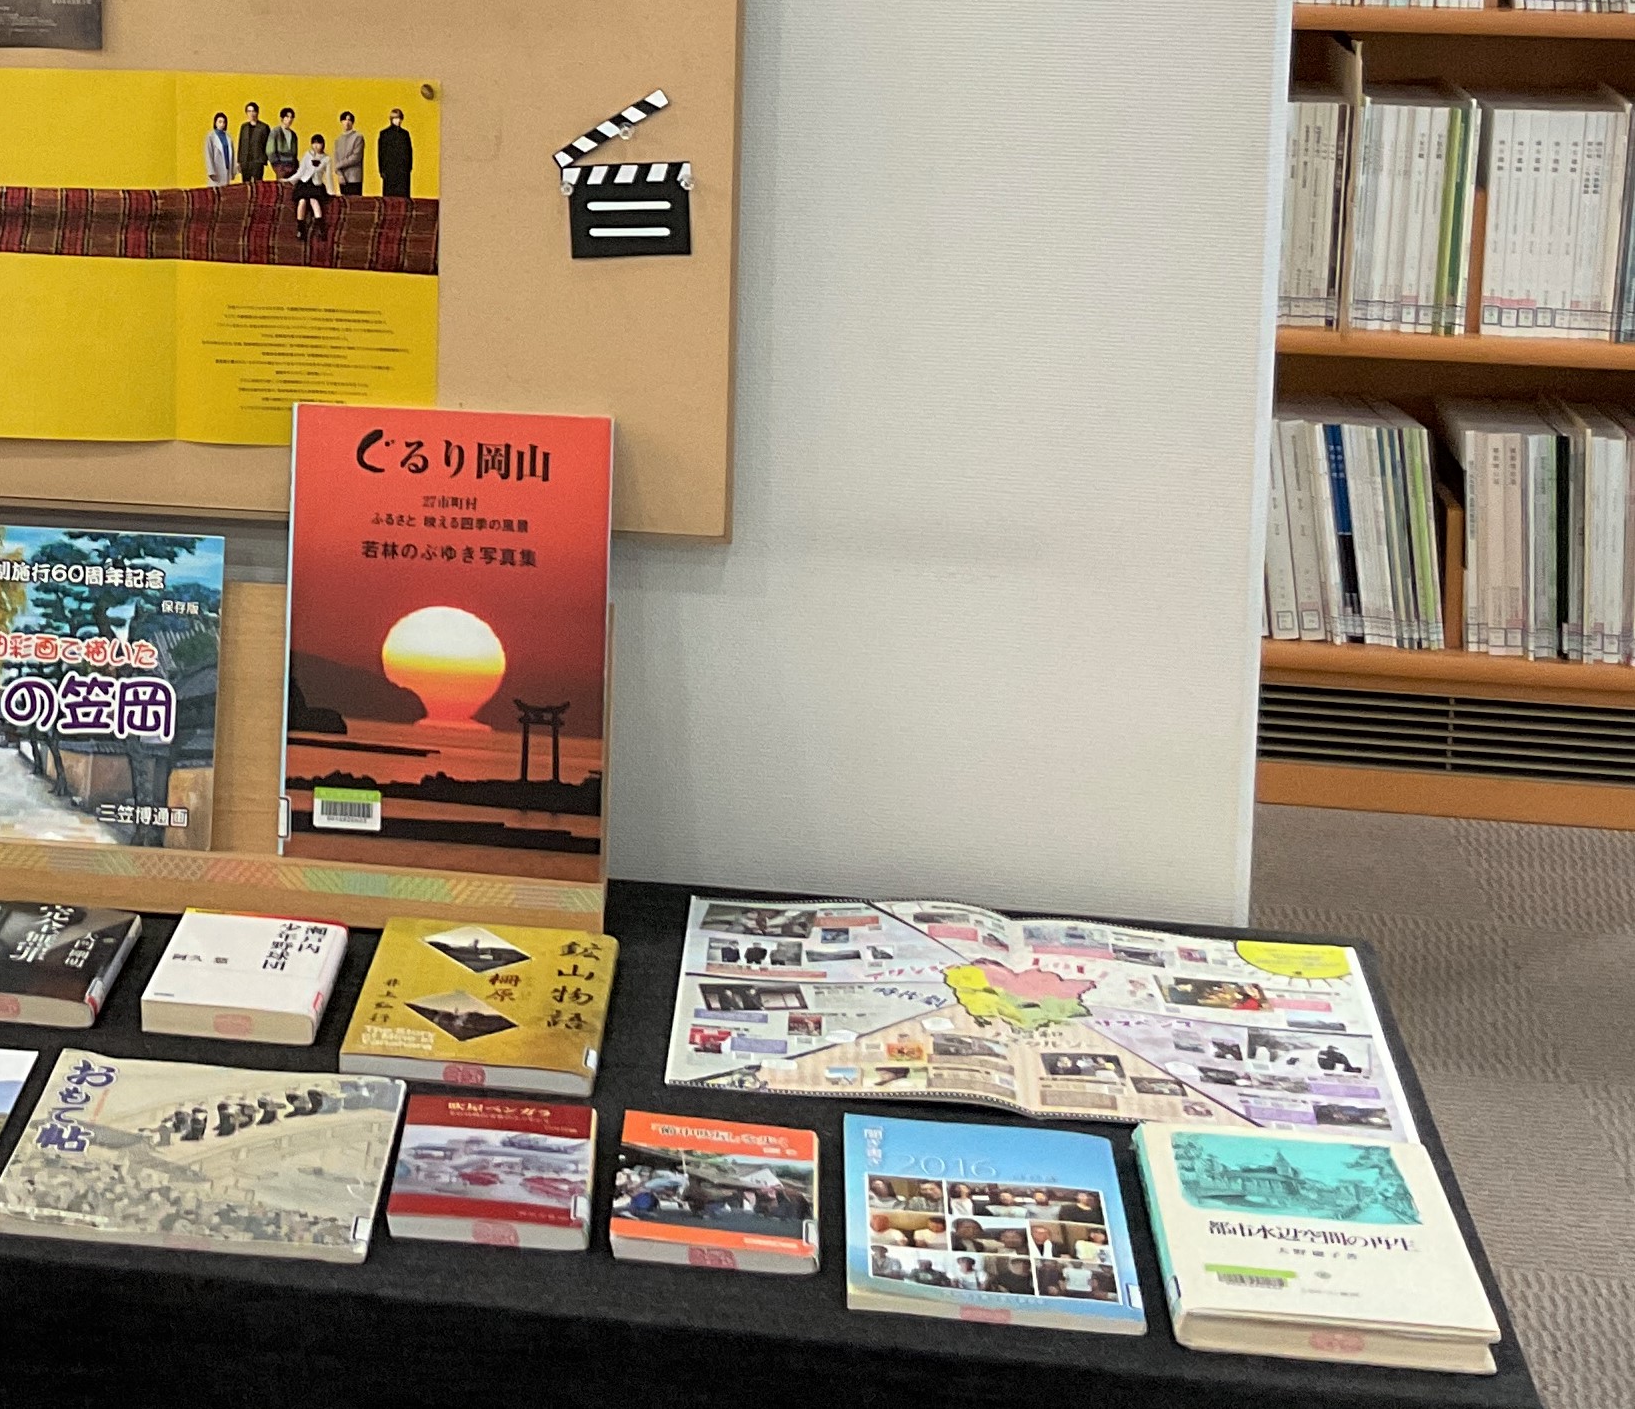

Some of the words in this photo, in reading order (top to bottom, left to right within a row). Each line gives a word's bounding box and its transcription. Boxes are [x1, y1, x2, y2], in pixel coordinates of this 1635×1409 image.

[355, 428, 552, 483] ぐるり岡山
[371, 512, 417, 528] ふるさと
[360, 539, 539, 569] 若林のぶゆき写真集
[161, 599, 201, 616] 保存版
[896, 1152, 1000, 1180] 2016
[1206, 1219, 1422, 1253] 都市水辺空間の再生
